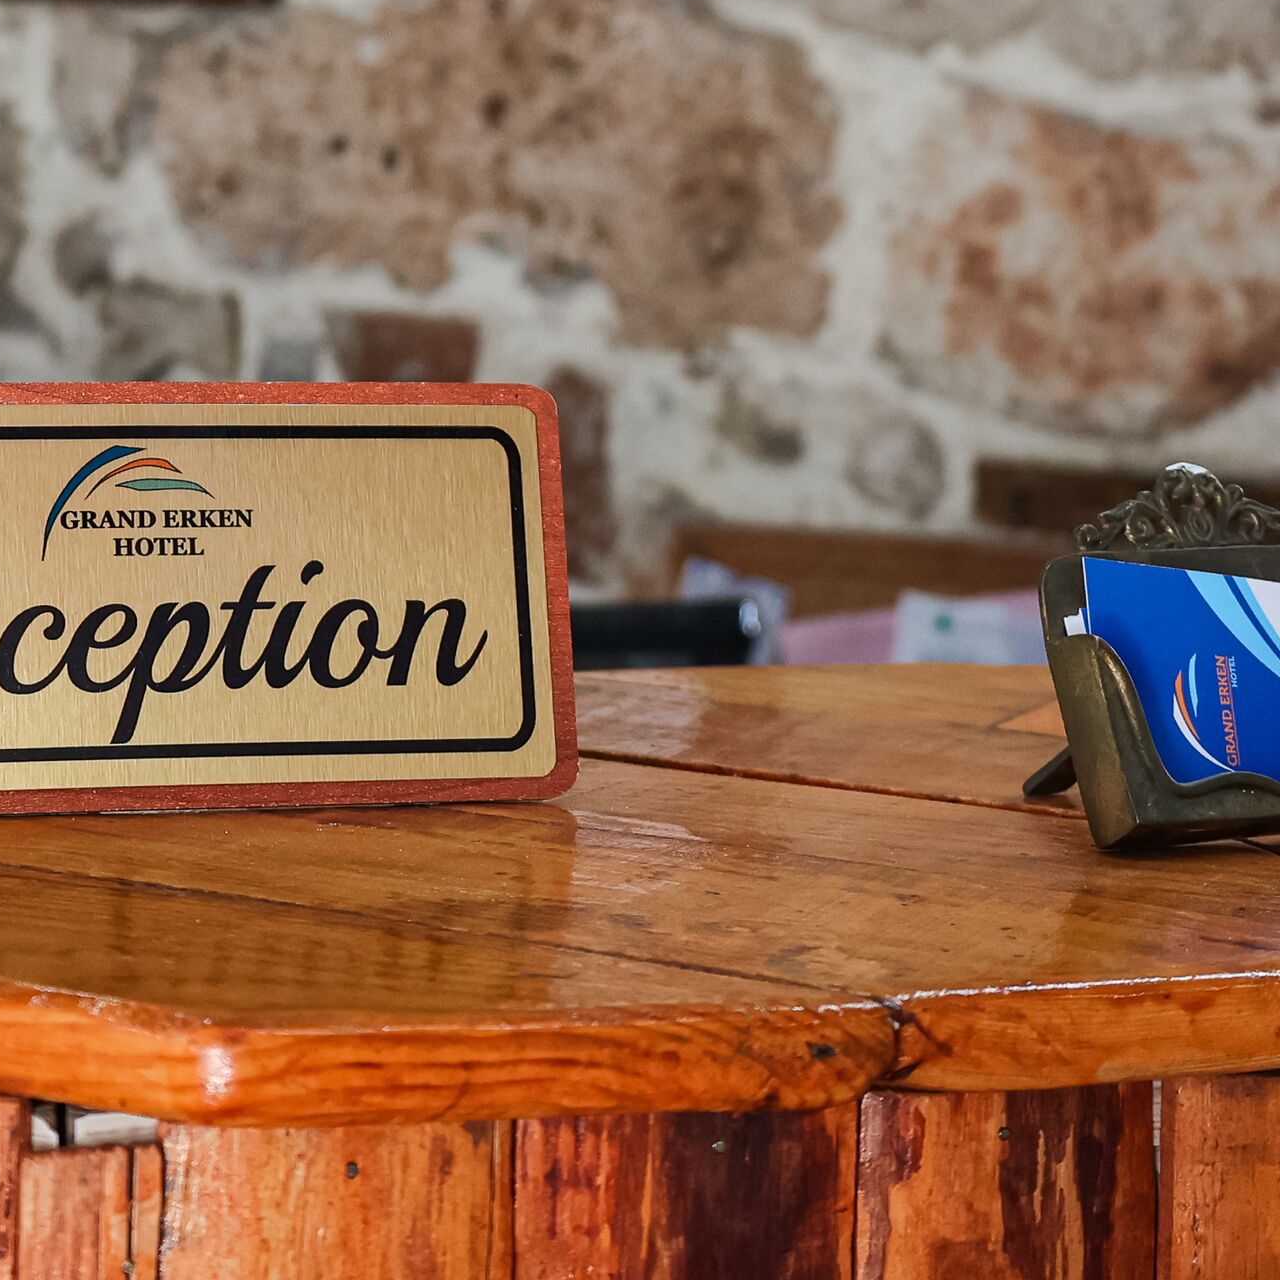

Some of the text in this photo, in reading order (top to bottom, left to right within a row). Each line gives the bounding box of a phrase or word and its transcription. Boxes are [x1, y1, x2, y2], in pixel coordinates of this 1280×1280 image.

[59, 508, 254, 530] GRAND ERKEN
[112, 536, 205, 557] HOTEL
[1228, 655, 1238, 688] HOTEL
[1215, 654, 1238, 767] GRAND ERKEN
